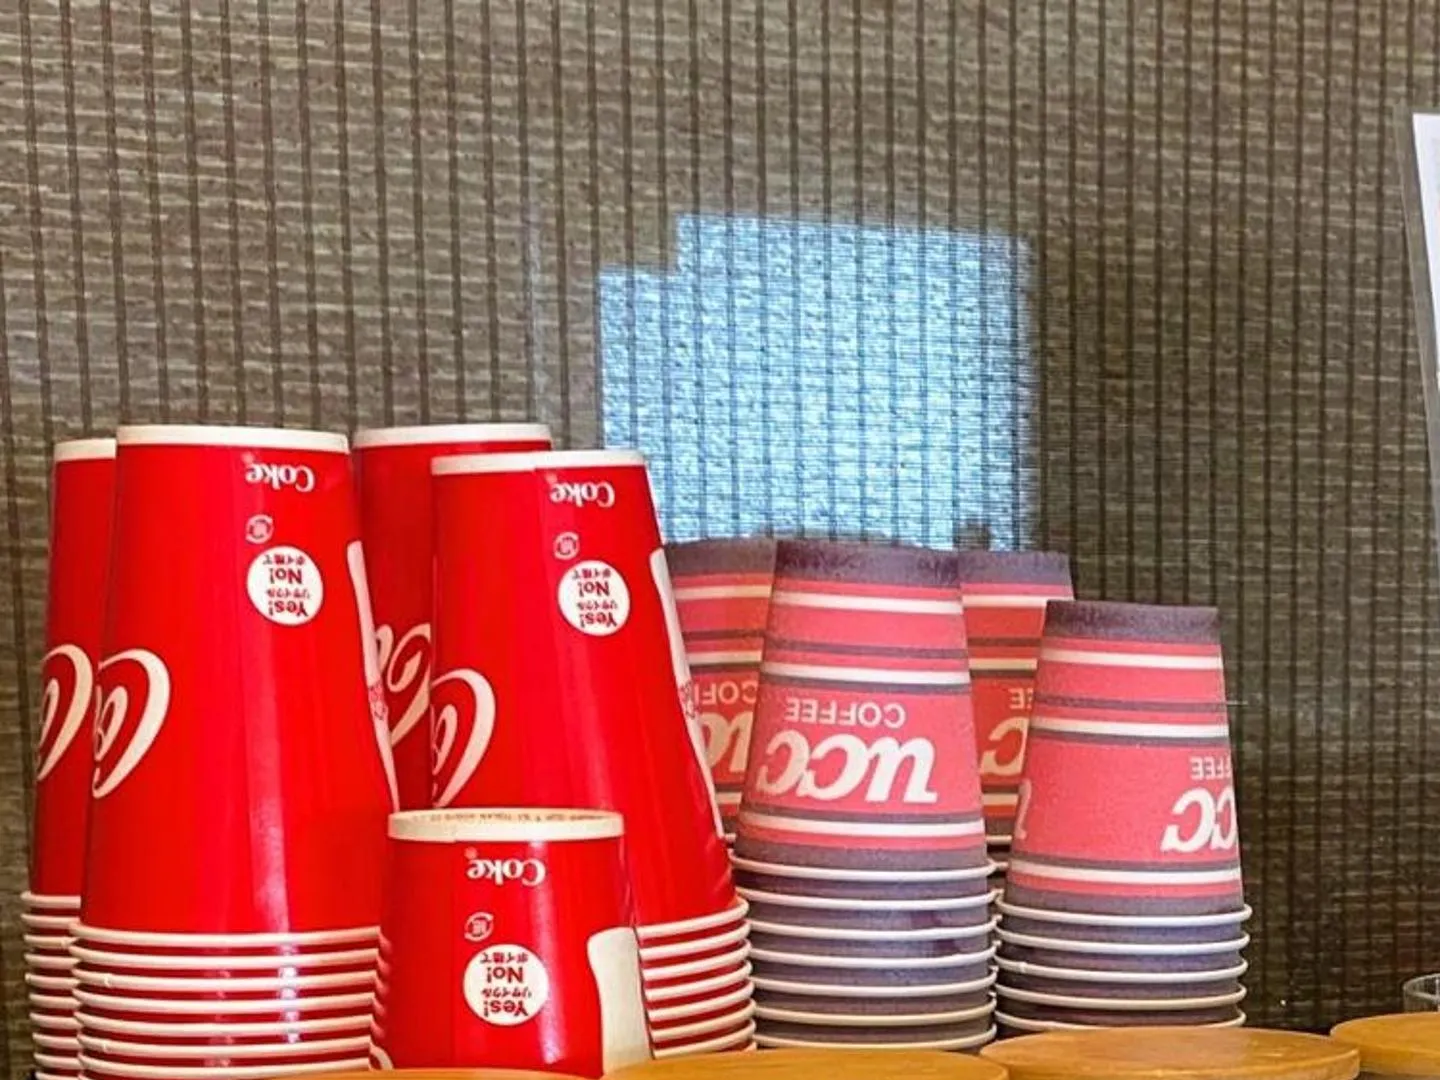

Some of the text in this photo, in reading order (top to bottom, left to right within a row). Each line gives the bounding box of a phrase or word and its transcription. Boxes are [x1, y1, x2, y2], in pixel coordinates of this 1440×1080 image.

[245, 463, 316, 493] Coke
[550, 480, 616, 508] Coke
[268, 567, 303, 585] No!
[577, 581, 610, 598] No!
[268, 600, 309, 617] Yes!
[579, 611, 618, 629] Yes!
[784, 697, 907, 729] COFFEE
[466, 858, 547, 887] Coke
[486, 965, 523, 984] No!
[483, 999, 529, 1018] Yes!
